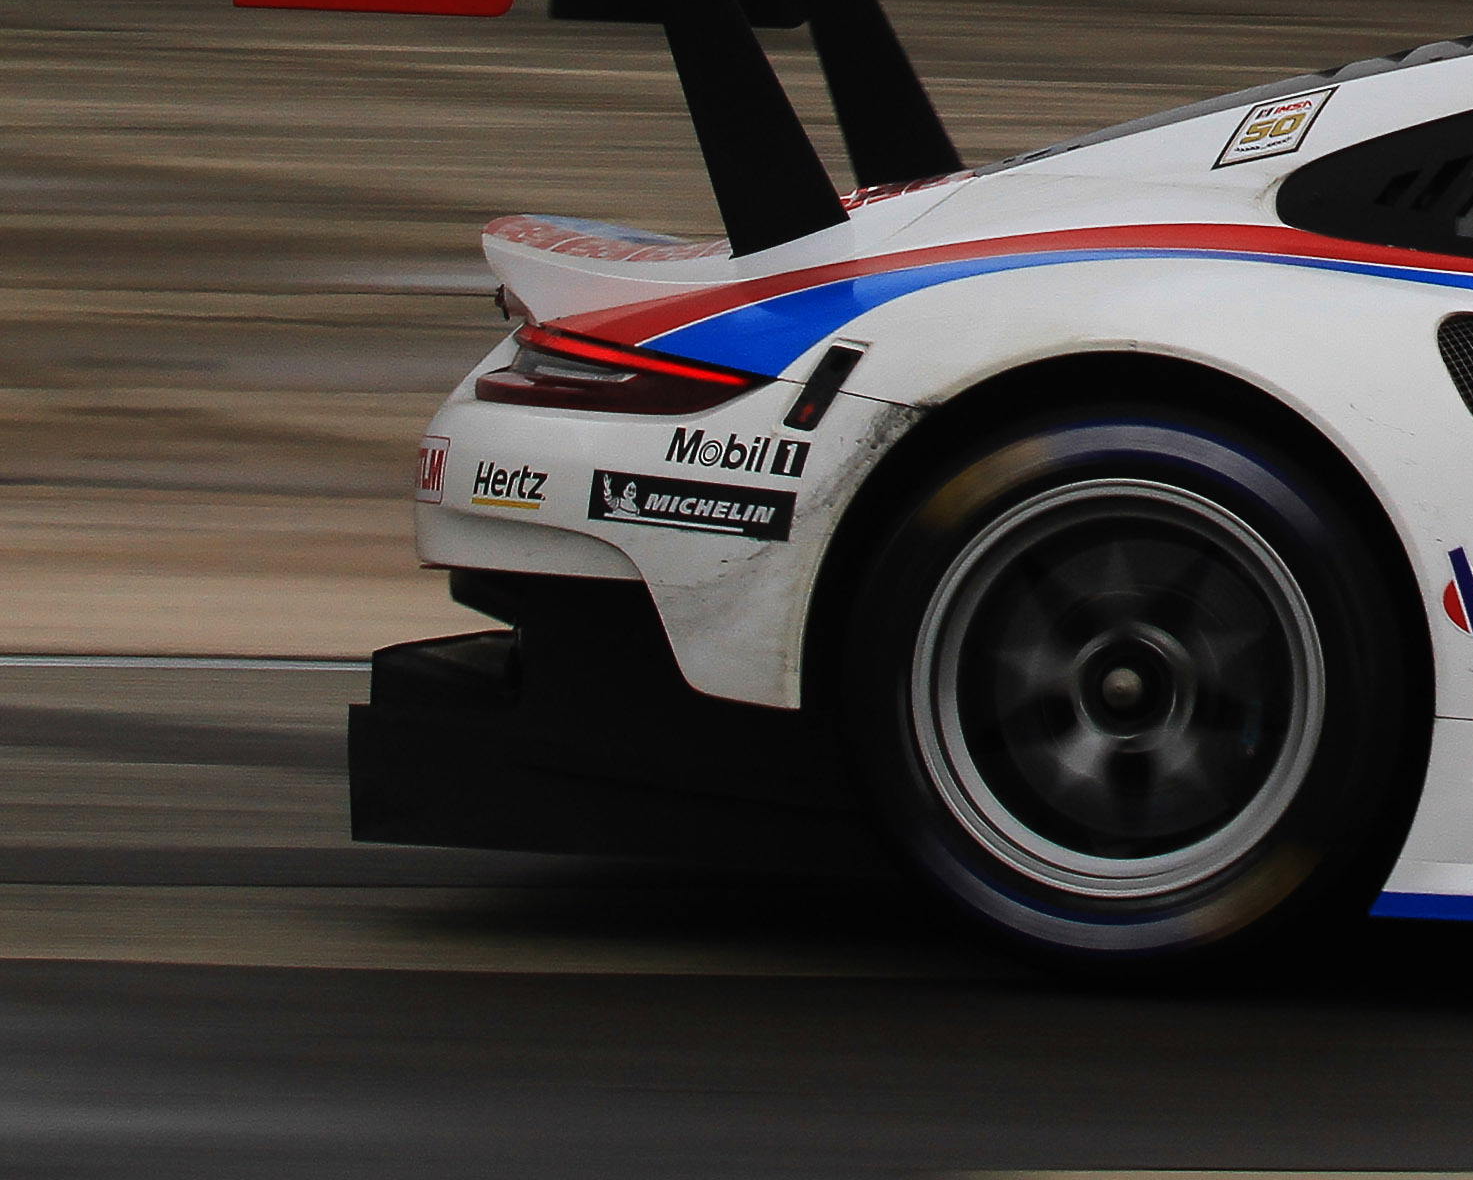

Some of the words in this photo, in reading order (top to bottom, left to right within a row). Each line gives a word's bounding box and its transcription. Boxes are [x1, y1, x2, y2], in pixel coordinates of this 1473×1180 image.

[1240, 112, 1306, 145] 50
[665, 426, 771, 473] Mobil
[770, 439, 811, 478] 1
[472, 460, 548, 501] Hertz
[644, 493, 776, 524] MICHELIN
